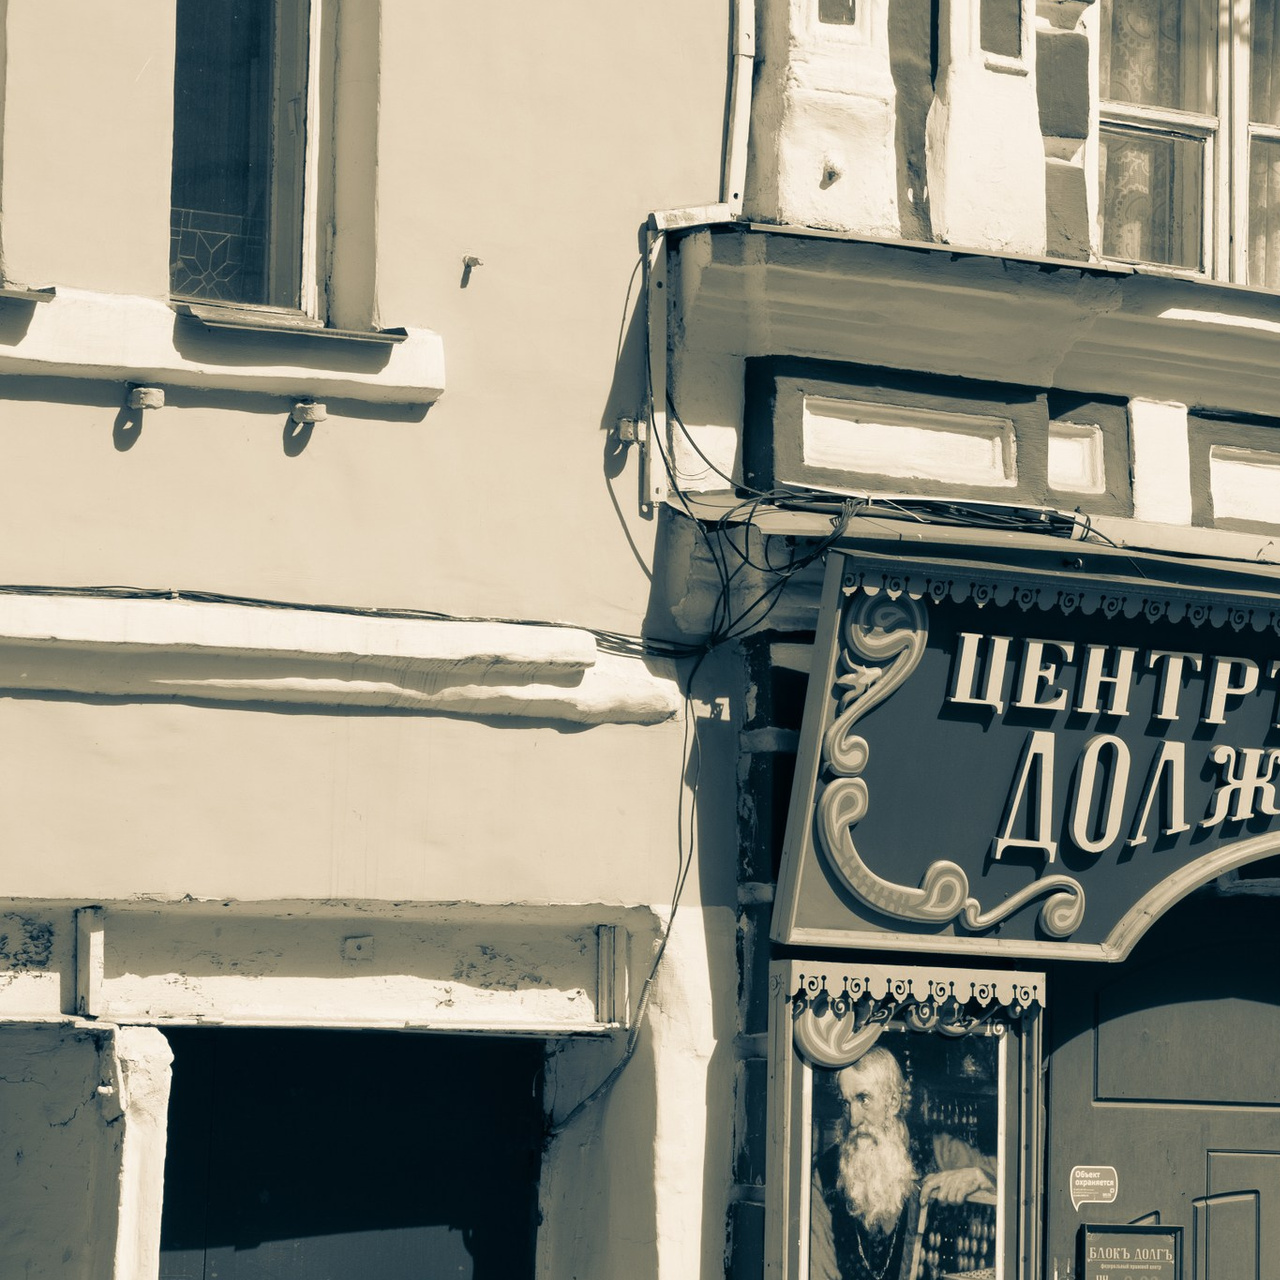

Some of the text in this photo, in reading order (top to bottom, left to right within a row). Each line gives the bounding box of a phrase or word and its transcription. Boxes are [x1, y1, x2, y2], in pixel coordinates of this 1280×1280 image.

[1074, 1170, 1101, 1179] Объект
[1074, 1179, 1115, 1187] охраняется
[1089, 1247, 1173, 1261] БЛОКЪ ДОЛГЪ
